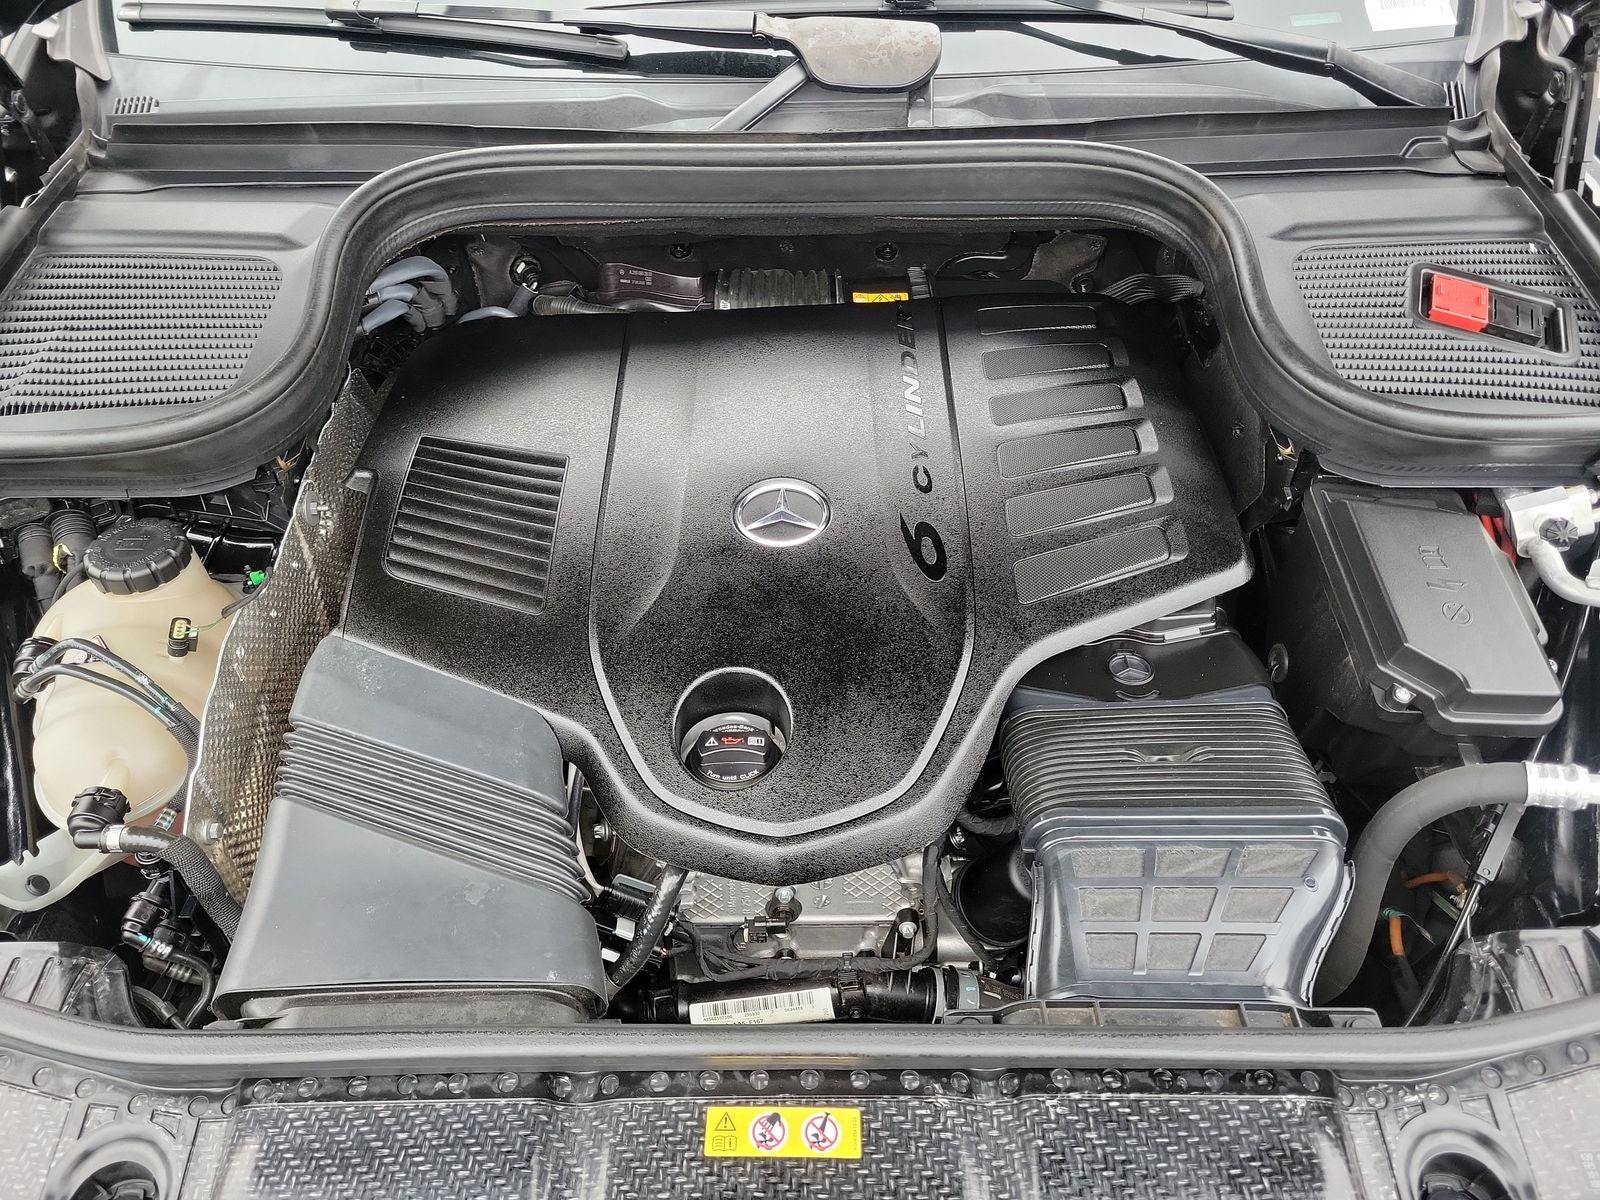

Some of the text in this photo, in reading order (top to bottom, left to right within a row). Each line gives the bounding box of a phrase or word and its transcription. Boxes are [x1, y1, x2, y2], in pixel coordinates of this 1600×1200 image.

[898, 306, 948, 582] 6 CYLINDER
[706, 769, 721, 780] Turn
[740, 769, 760, 780] CLICK
[153, 941, 171, 954] TOP
